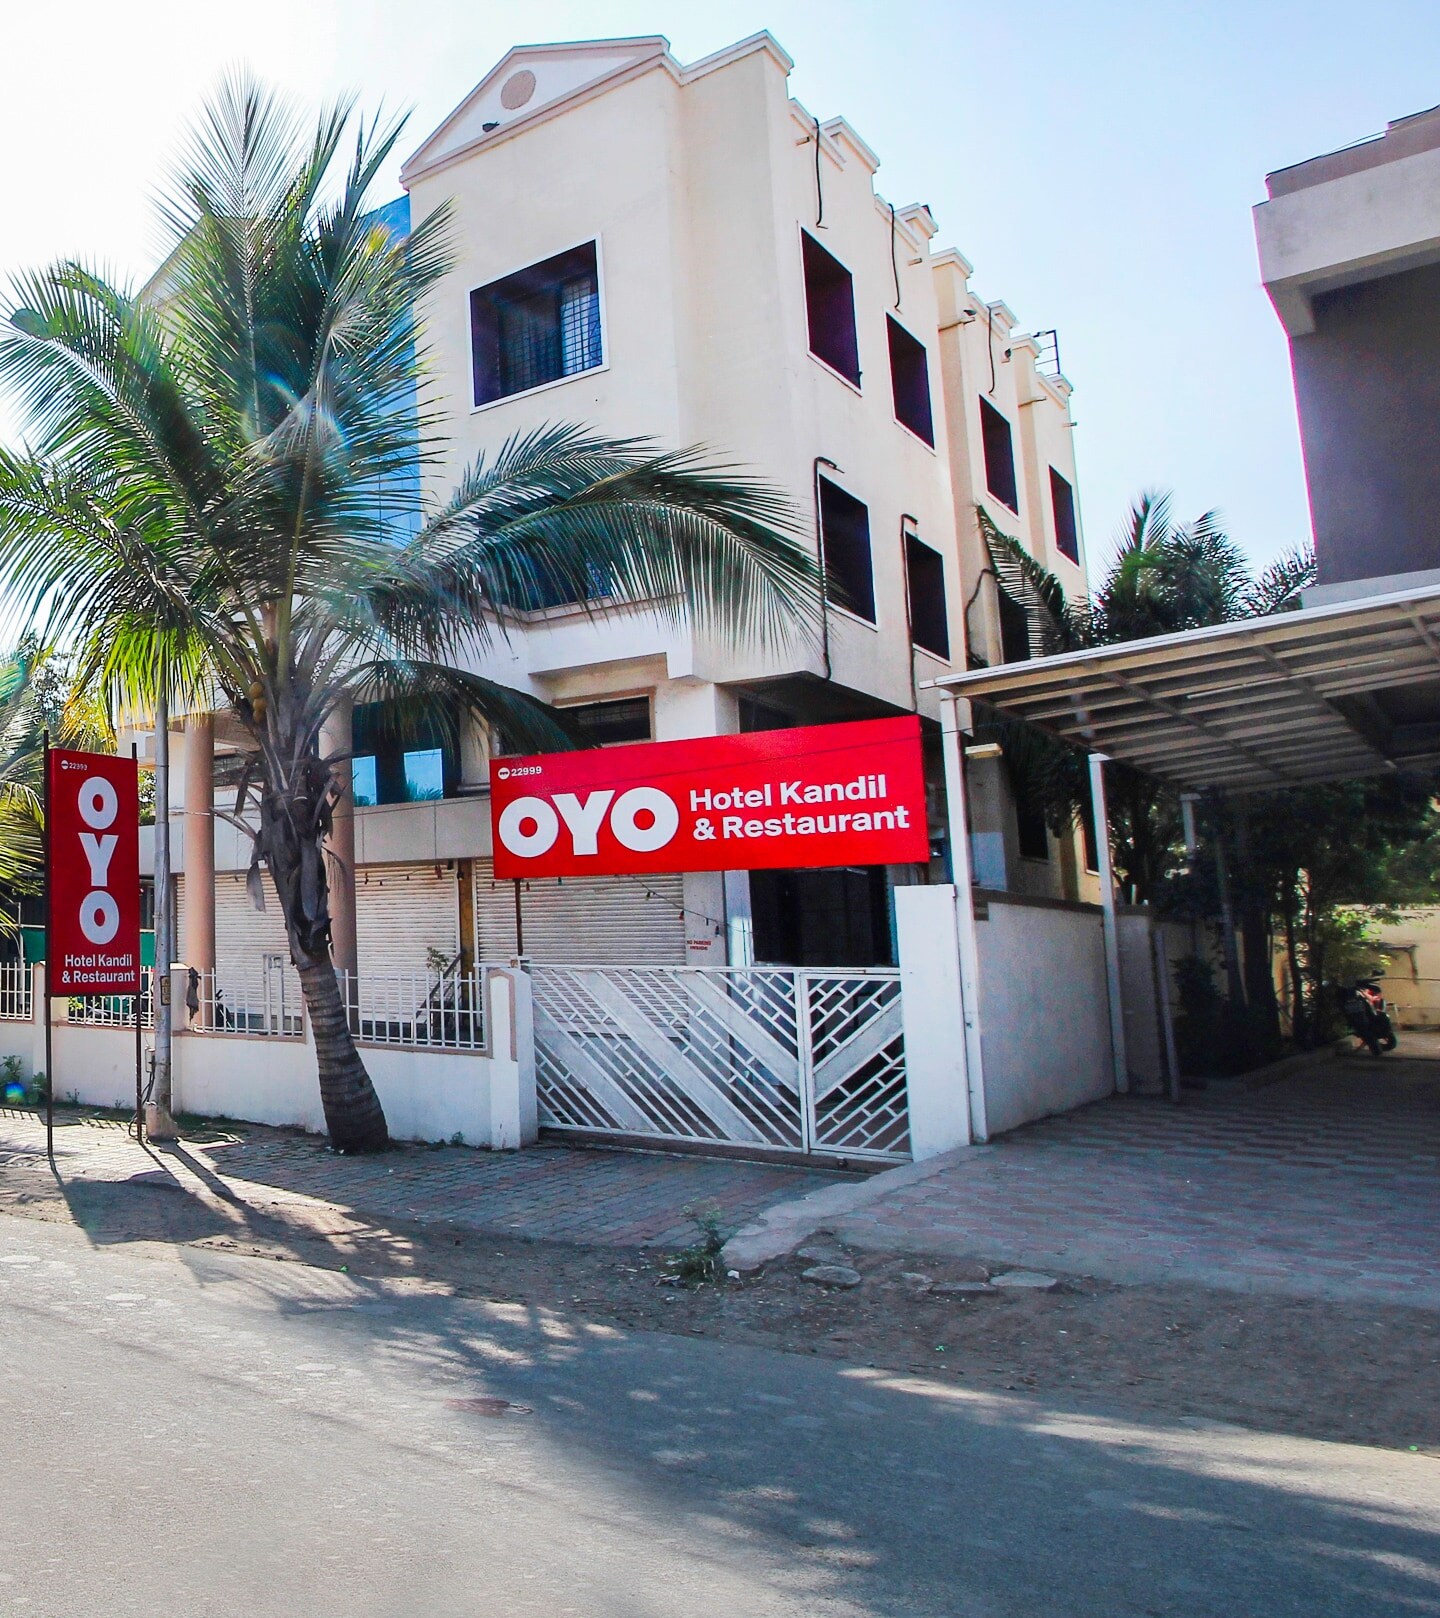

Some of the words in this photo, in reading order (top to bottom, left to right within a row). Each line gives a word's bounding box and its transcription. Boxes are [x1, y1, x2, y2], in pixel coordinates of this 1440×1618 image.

[511, 766, 542, 777] 22999
[689, 783, 772, 812] Hotel
[780, 774, 887, 805] Kandil
[498, 786, 680, 858] OYO
[693, 818, 717, 841] &
[722, 805, 910, 839] Restaurant
[78, 776, 120, 945] OYO
[61, 970, 72, 983] &
[73, 970, 136, 984] Restaurant
[64, 954, 96, 967] Hotel
[98, 954, 133, 967] Kandil
